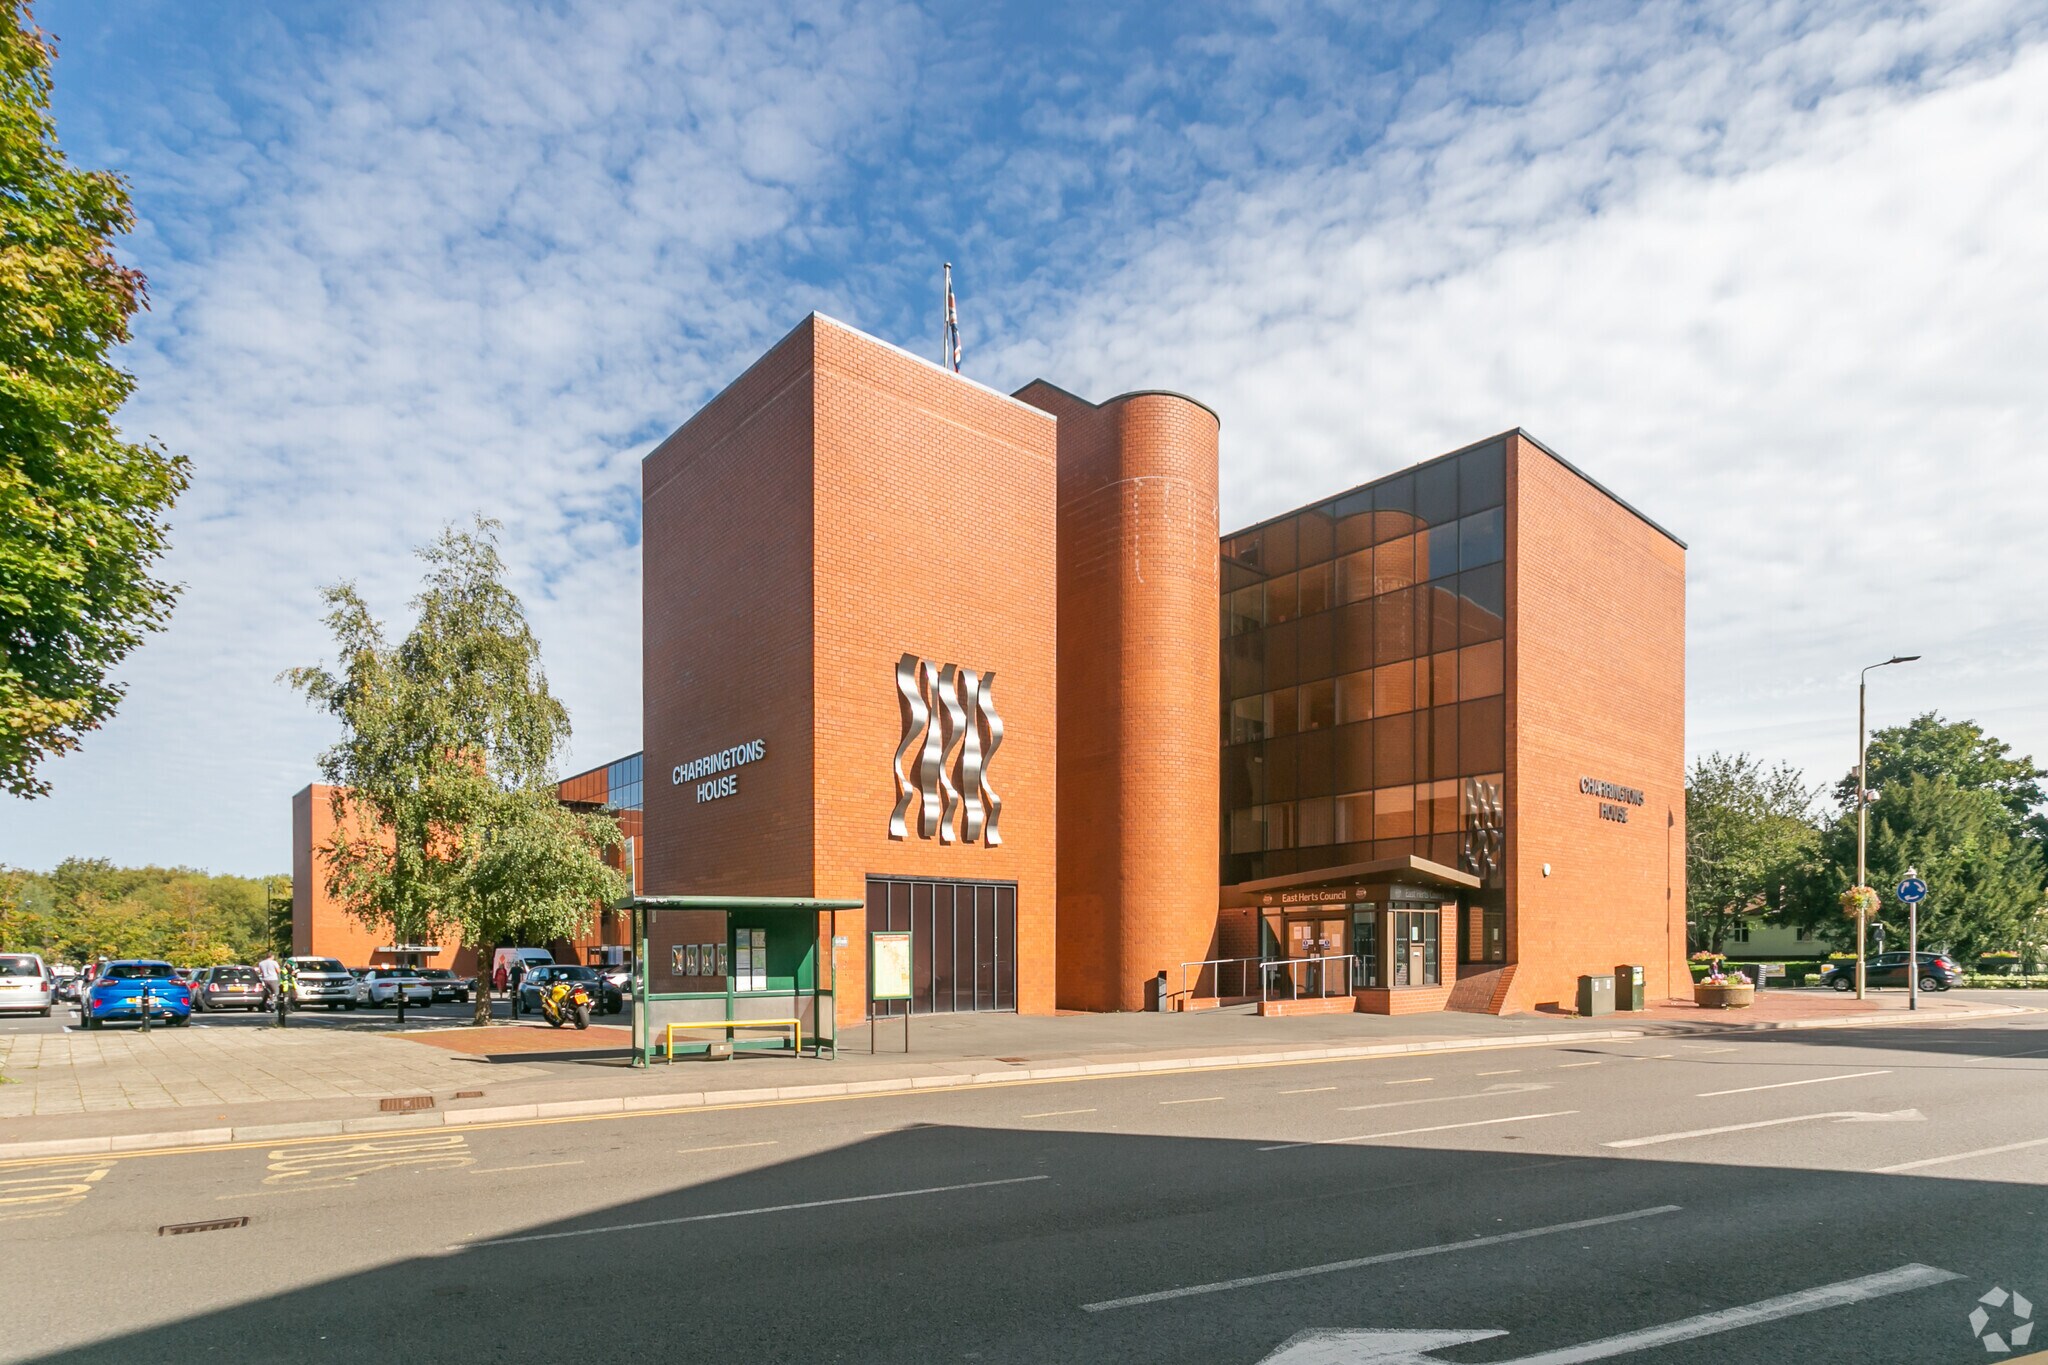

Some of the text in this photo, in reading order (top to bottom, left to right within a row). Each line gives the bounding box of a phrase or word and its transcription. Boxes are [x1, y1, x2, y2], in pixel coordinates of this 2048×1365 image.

[672, 738, 766, 785] CHARRINGTONS
[696, 774, 738, 803] HOUSE
[1579, 776, 1644, 806] CHARRINGTONS
[1599, 802, 1629, 823] HOUSE
[1282, 893, 1298, 903] East
[1298, 892, 1319, 902] Herts
[1319, 890, 1347, 901] Council
[261, 1134, 478, 1185] BUS
